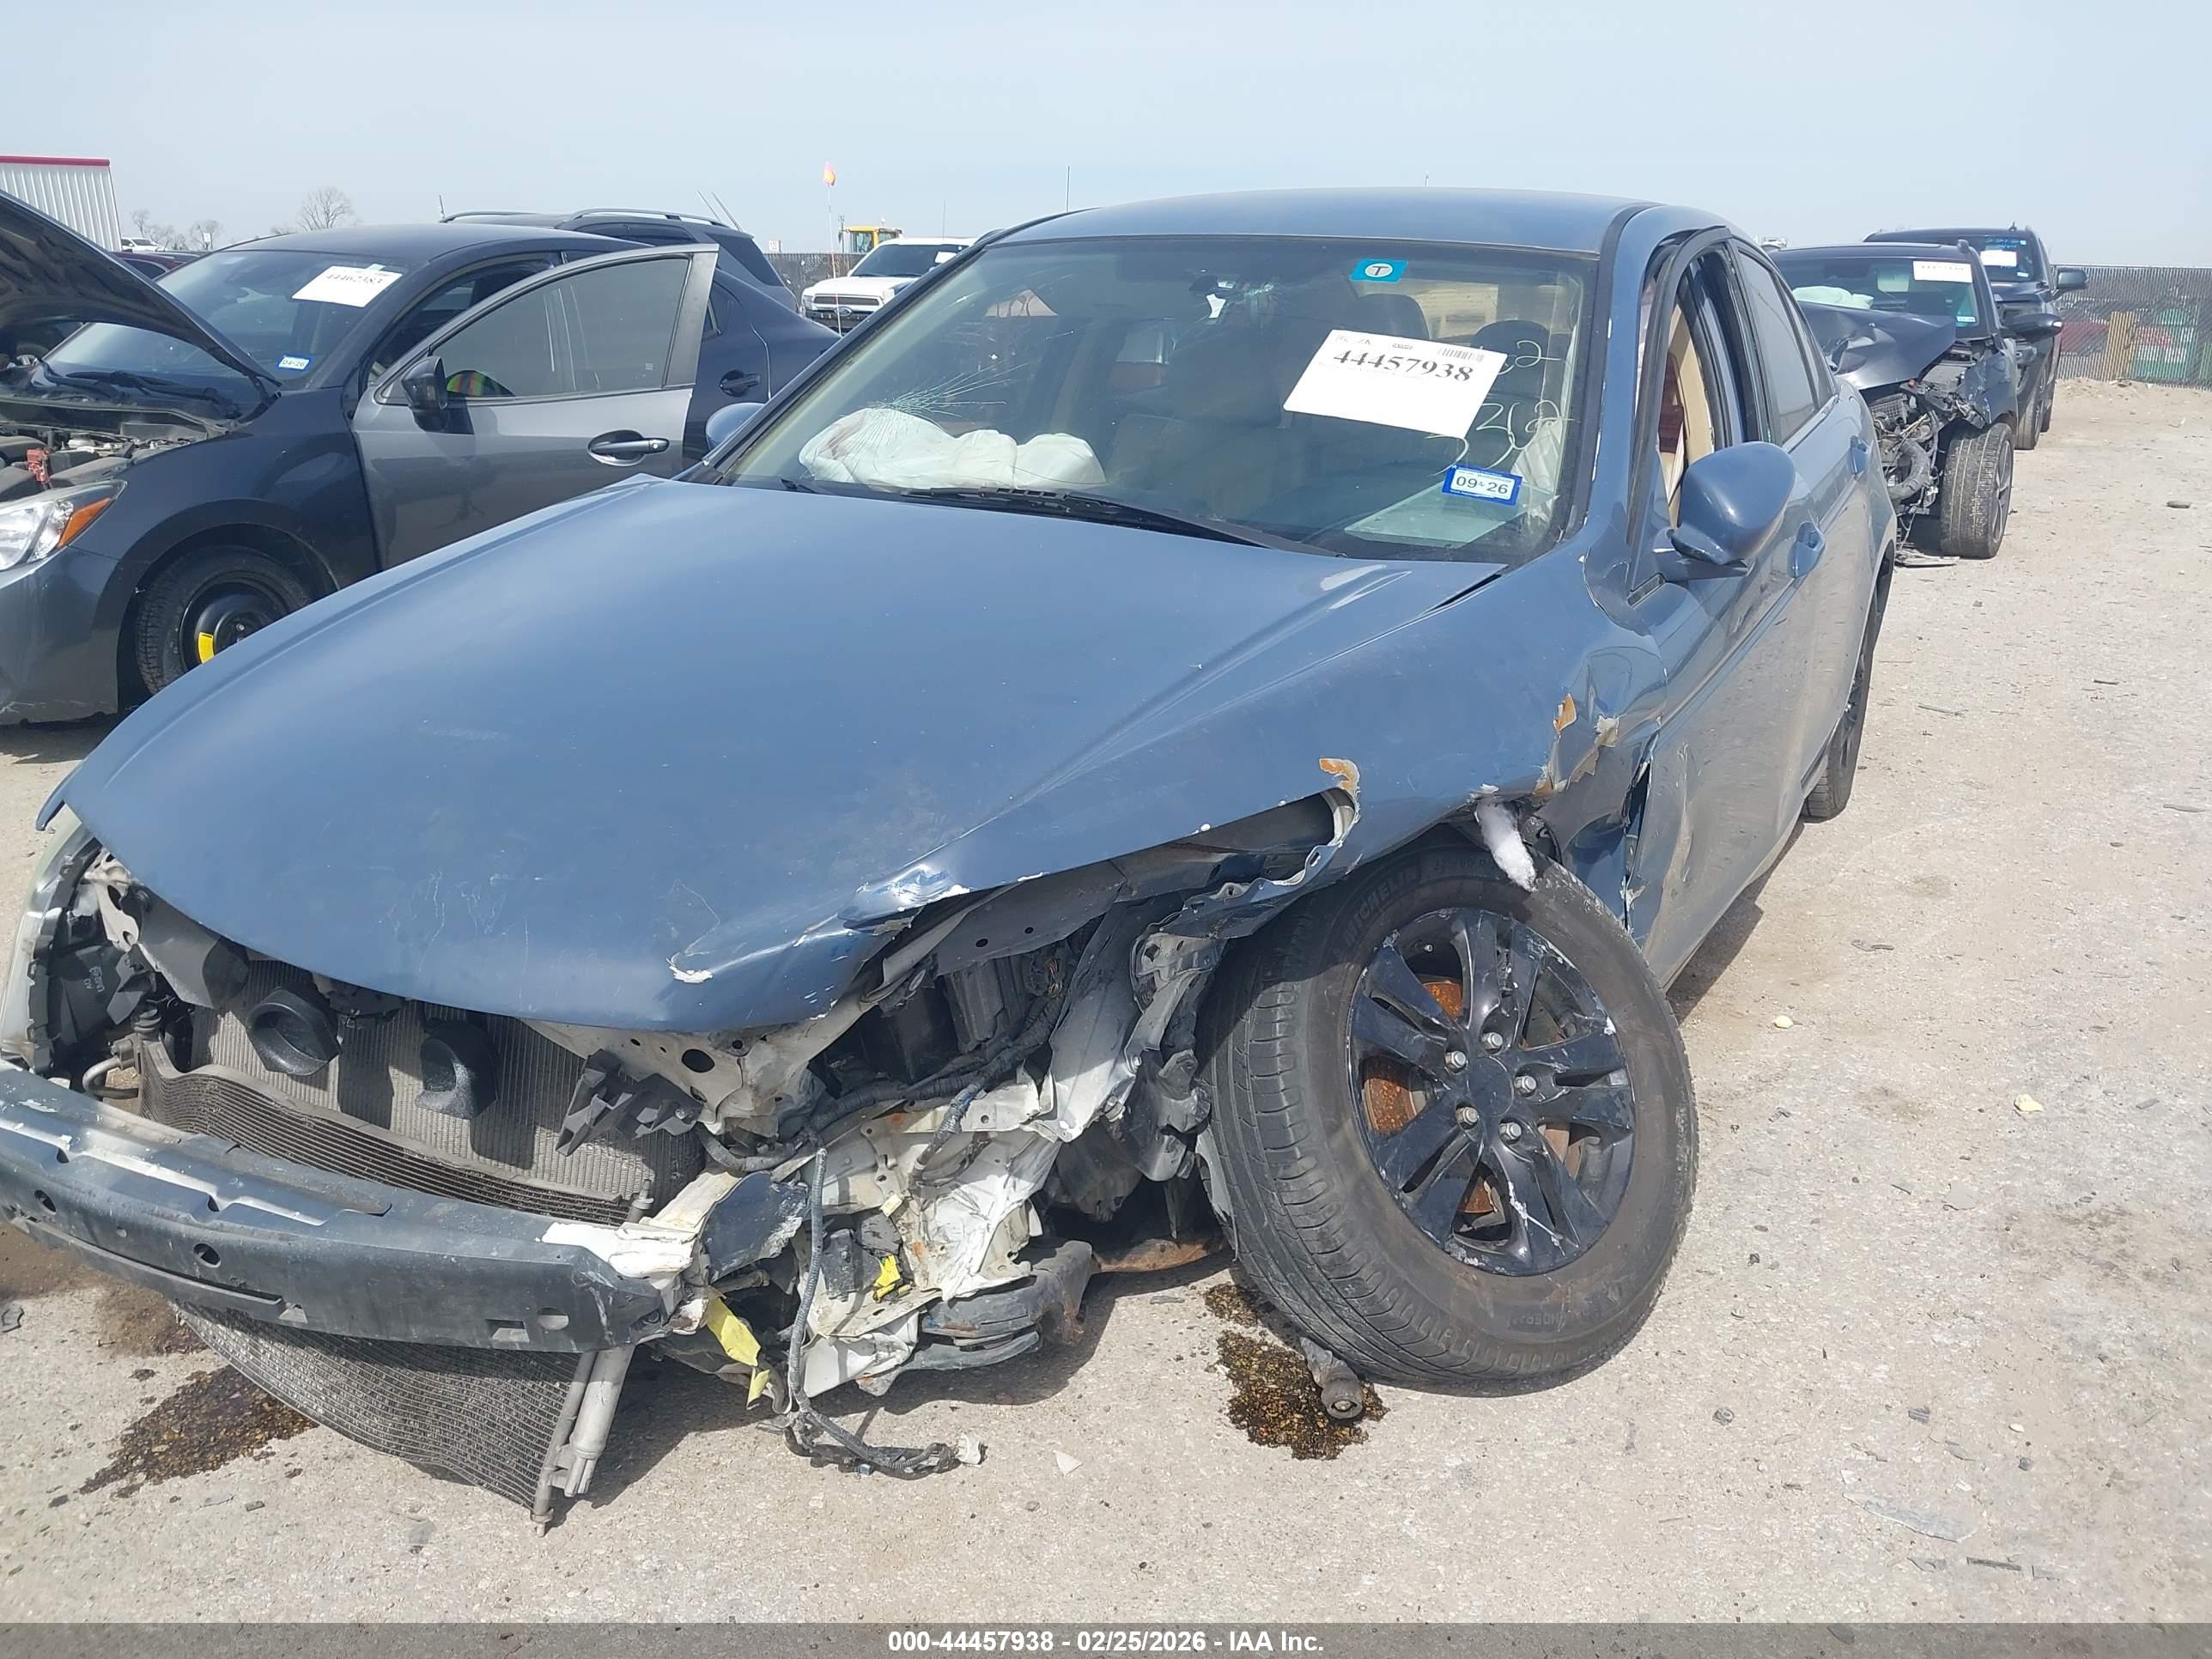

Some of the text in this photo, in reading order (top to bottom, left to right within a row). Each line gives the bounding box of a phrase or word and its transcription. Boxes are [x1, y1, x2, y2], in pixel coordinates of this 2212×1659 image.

[1371, 265, 1389, 276] T
[1333, 349, 1474, 382] 44457938
[1486, 482, 1509, 495] 26
